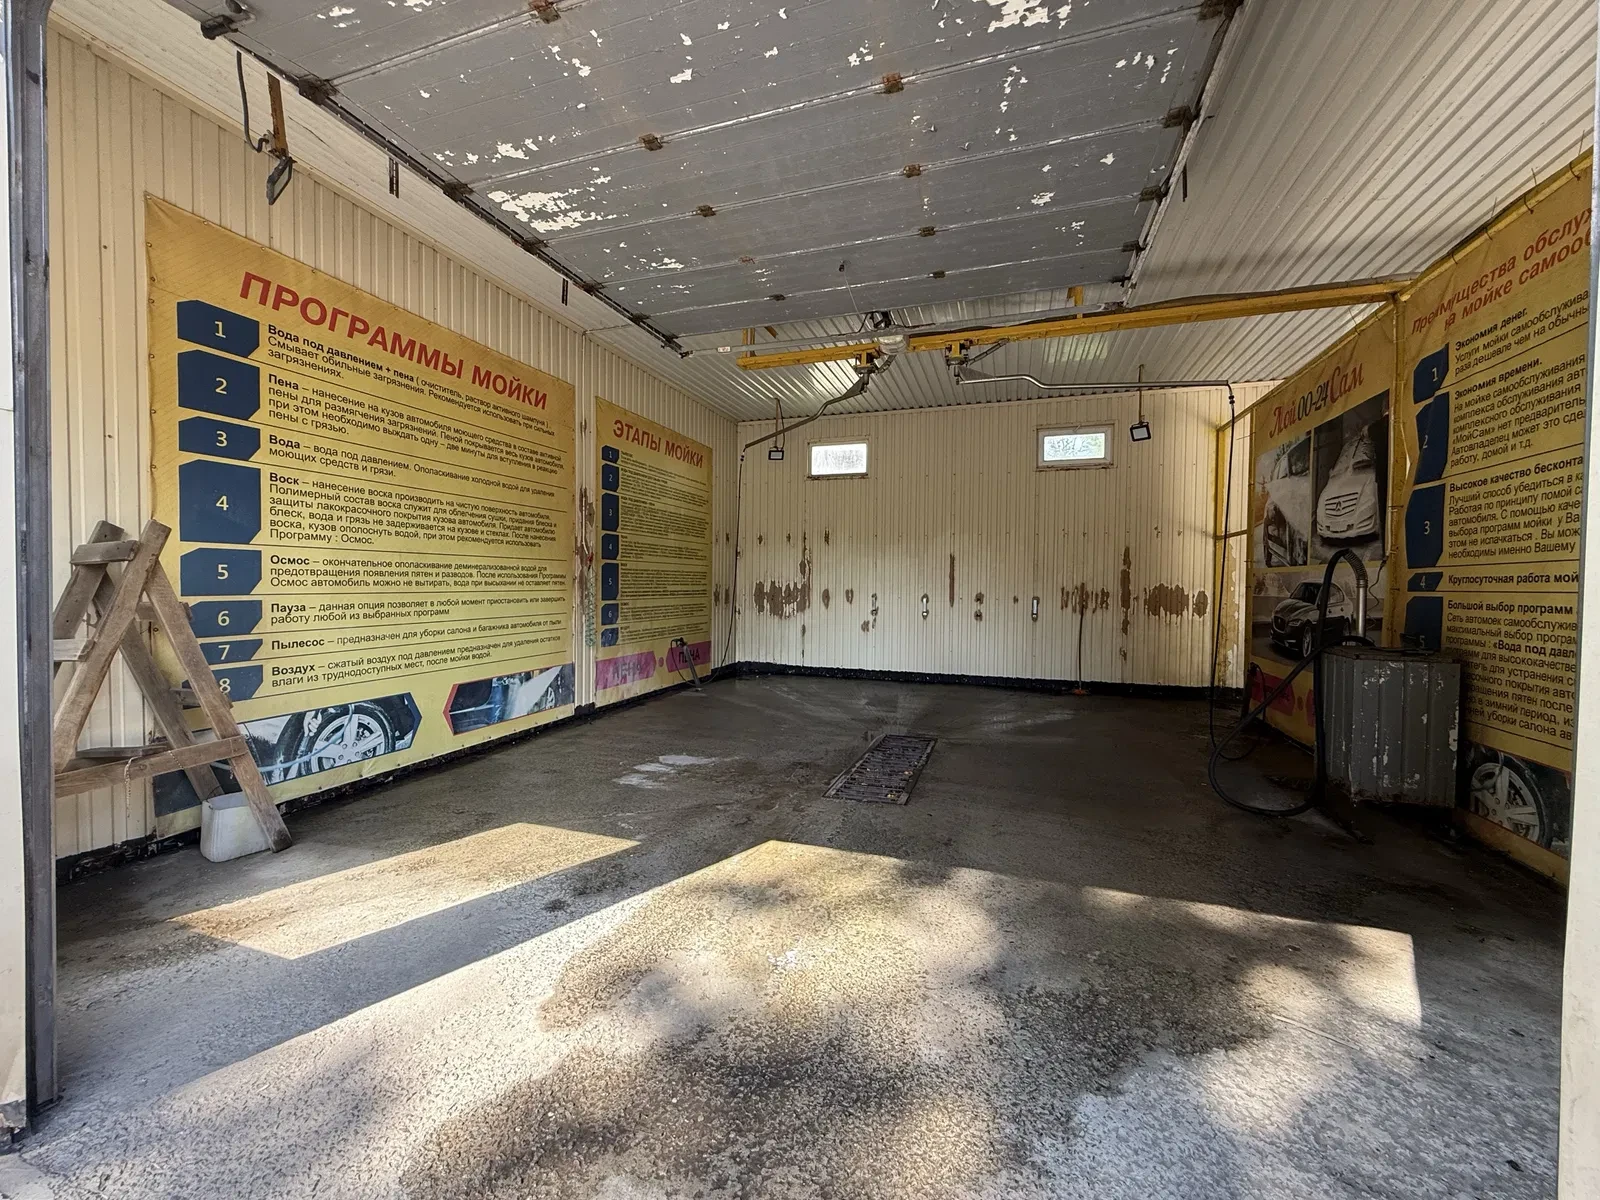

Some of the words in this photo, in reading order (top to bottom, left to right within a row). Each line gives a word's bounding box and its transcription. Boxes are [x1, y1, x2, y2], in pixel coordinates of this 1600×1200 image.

[1412, 255, 1516, 335] Преимущества
[1461, 279, 1512, 319] мойке
[214, 321, 226, 338] 1
[1455, 323, 1498, 351] Экономия
[240, 271, 464, 380] ПРОГРАММЫ
[472, 364, 547, 410] МОЙКИ
[268, 324, 299, 343] Вода
[302, 338, 324, 353] под
[326, 346, 383, 372] давлением
[1455, 345, 1480, 364] Услуги
[1483, 333, 1508, 352] мойки
[267, 336, 320, 360] Смывает
[321, 355, 371, 377] обильные
[1455, 361, 1471, 377] раза
[1472, 342, 1512, 369] дешевле
[1514, 332, 1531, 345] чем
[1328, 363, 1364, 403] Сам
[1432, 367, 1438, 382] 1
[1464, 393, 1491, 409] мойке
[1493, 353, 1586, 399] самообслуживания
[215, 378, 227, 394] 2
[1454, 376, 1496, 400] Экономия
[1496, 375, 1564, 409] обслуживания
[268, 373, 299, 390] Пена
[311, 387, 365, 408] нанесение
[367, 403, 379, 412] на
[380, 407, 404, 419] кузов
[268, 386, 298, 401] пены
[300, 395, 322, 407] для
[324, 401, 385, 424] размягчения
[1509, 383, 1581, 415] обслуживания
[268, 398, 290, 410] при
[292, 404, 319, 417] этом
[321, 411, 380, 432] необходимо
[268, 409, 298, 423] пены
[301, 417, 308, 425] с
[216, 431, 228, 446] 3
[613, 419, 661, 452] ЭТАПЫ
[665, 440, 703, 468] МОЙКИ
[1423, 434, 1428, 449] 2
[1451, 432, 1510, 456] Автовладелец
[1512, 423, 1540, 440] может
[1543, 417, 1560, 430] это
[269, 434, 300, 449] Вода
[313, 445, 338, 456] вода
[340, 450, 359, 461] под
[1481, 444, 1509, 461] домой
[269, 447, 316, 463] моющих
[319, 456, 359, 470] средств
[361, 464, 367, 472] и
[269, 472, 299, 485] Воск
[312, 480, 365, 494] нанесение
[367, 488, 392, 498] воска
[1449, 478, 1488, 493] Высокое
[1490, 468, 1532, 484] качество
[269, 483, 340, 501] Полимерный
[343, 495, 375, 505] состав
[377, 499, 402, 509] воска
[1449, 491, 1481, 505] Лучший
[1482, 484, 1512, 499] способ
[1514, 475, 1564, 495] убедиться
[216, 496, 228, 510] 4
[269, 496, 313, 508] защиты
[316, 502, 392, 517] лакокрасочного
[1449, 504, 1482, 516] Работая
[1495, 493, 1540, 512] принципу
[1509, 504, 1555, 520] помощью
[308, 511, 333, 521] вода
[336, 514, 342, 522] и
[345, 515, 370, 525] грязь
[372, 518, 384, 526] не
[1424, 520, 1431, 535] 3
[1480, 521, 1521, 536] программ
[1523, 516, 1553, 529] мойки
[270, 528, 332, 543] Программу
[308, 522, 336, 532] кузов
[339, 525, 392, 536] ополоснуть
[1480, 532, 1532, 545] испачкаться
[1541, 528, 1554, 539] Вы
[1448, 547, 1496, 559] необходимы
[1498, 544, 1532, 555] именно
[1534, 541, 1576, 553] Вашему
[270, 554, 310, 565] Осмос
[322, 558, 392, 567] окончательное
[217, 564, 229, 580] 5
[270, 567, 360, 577] предотвращения
[362, 569, 409, 577] появления
[1448, 574, 1514, 586] Круглосуточная
[1516, 572, 1550, 586] работа
[270, 577, 308, 586] Осмос
[310, 577, 370, 586] автомобиль
[1420, 575, 1426, 588] 4
[271, 603, 306, 614] Пауза
[318, 603, 355, 612] данная
[357, 602, 385, 610] опция
[1447, 600, 1483, 610] Большой
[1485, 601, 1515, 614] выбор
[1517, 603, 1573, 616] программ
[217, 611, 230, 626] 6
[270, 613, 310, 625] работу
[312, 611, 346, 622] любой
[349, 612, 360, 620] из
[362, 610, 411, 619] выбранных
[271, 638, 324, 650] Пылесос
[336, 632, 400, 645] предназначен
[1446, 625, 1502, 638] максимальный
[1503, 630, 1533, 643] выбор
[218, 645, 230, 660] 7
[1525, 646, 1546, 657] под
[272, 664, 315, 676] Воздух
[327, 657, 364, 669] сжатый
[366, 655, 396, 665] воздух
[272, 676, 303, 687] влаги
[306, 674, 319, 682] из
[321, 663, 402, 681] труднодоступных
[1507, 667, 1564, 683] устранения
[219, 678, 231, 693] 8
[1505, 678, 1550, 695] покрытия
[1540, 699, 1573, 713] после
[1518, 719, 1557, 736] салона
